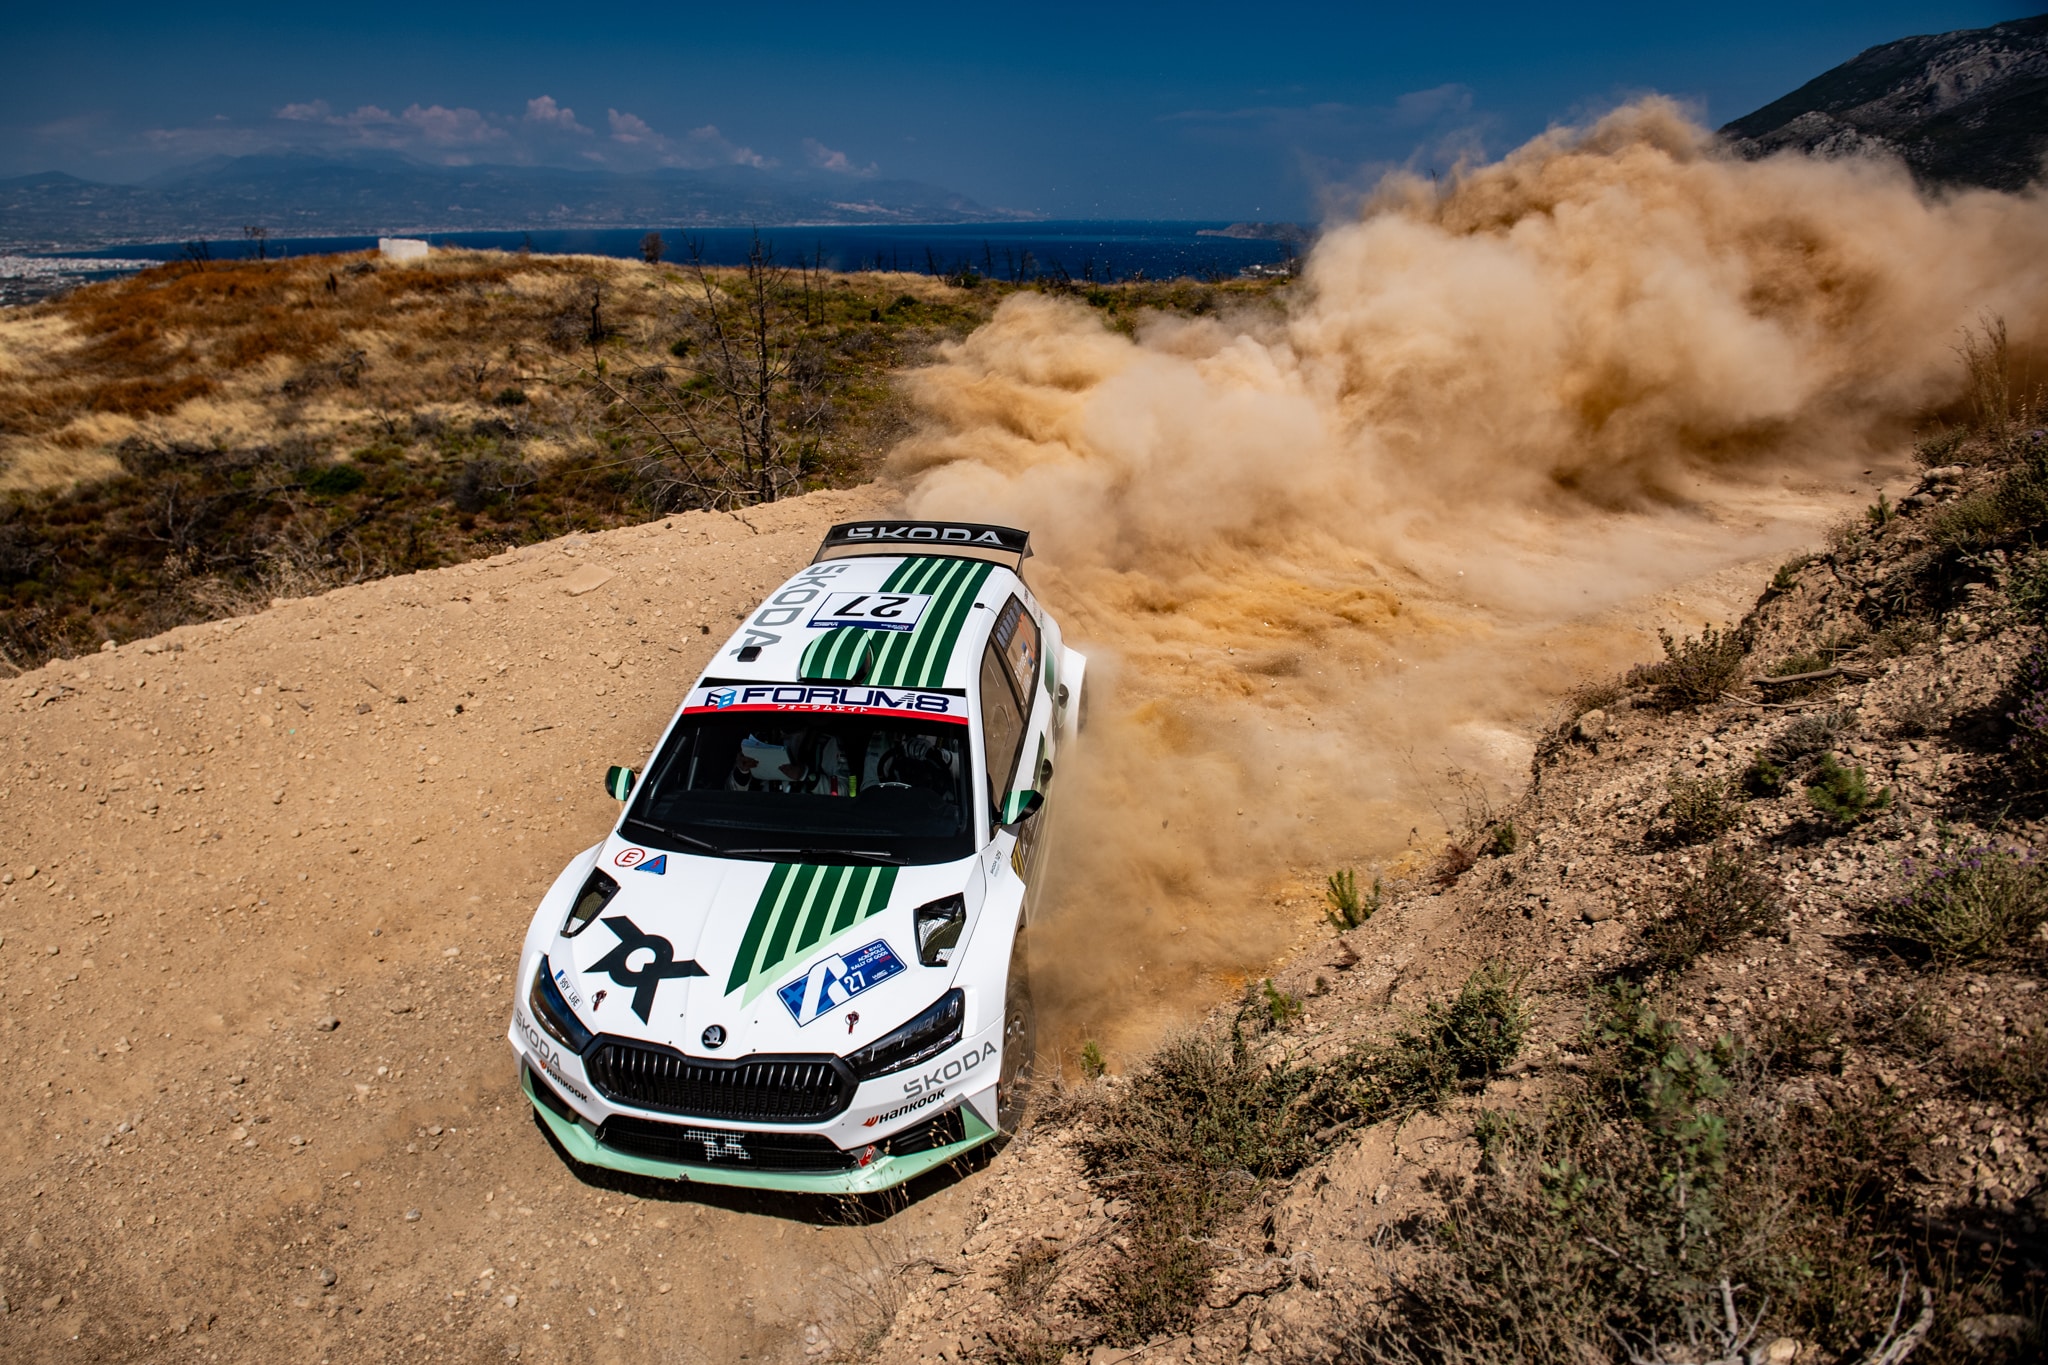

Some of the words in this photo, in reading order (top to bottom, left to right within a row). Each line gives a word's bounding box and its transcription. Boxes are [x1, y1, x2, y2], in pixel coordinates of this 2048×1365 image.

[833, 595, 910, 618] 27
[741, 687, 950, 713] FORUM8
[776, 703, 868, 713] フォーラムエイト
[622, 852, 638, 862] E
[851, 961, 866, 970] RALLY
[874, 951, 888, 959] GODS
[858, 947, 885, 961] ACROPOLIS
[843, 970, 865, 992] 27
